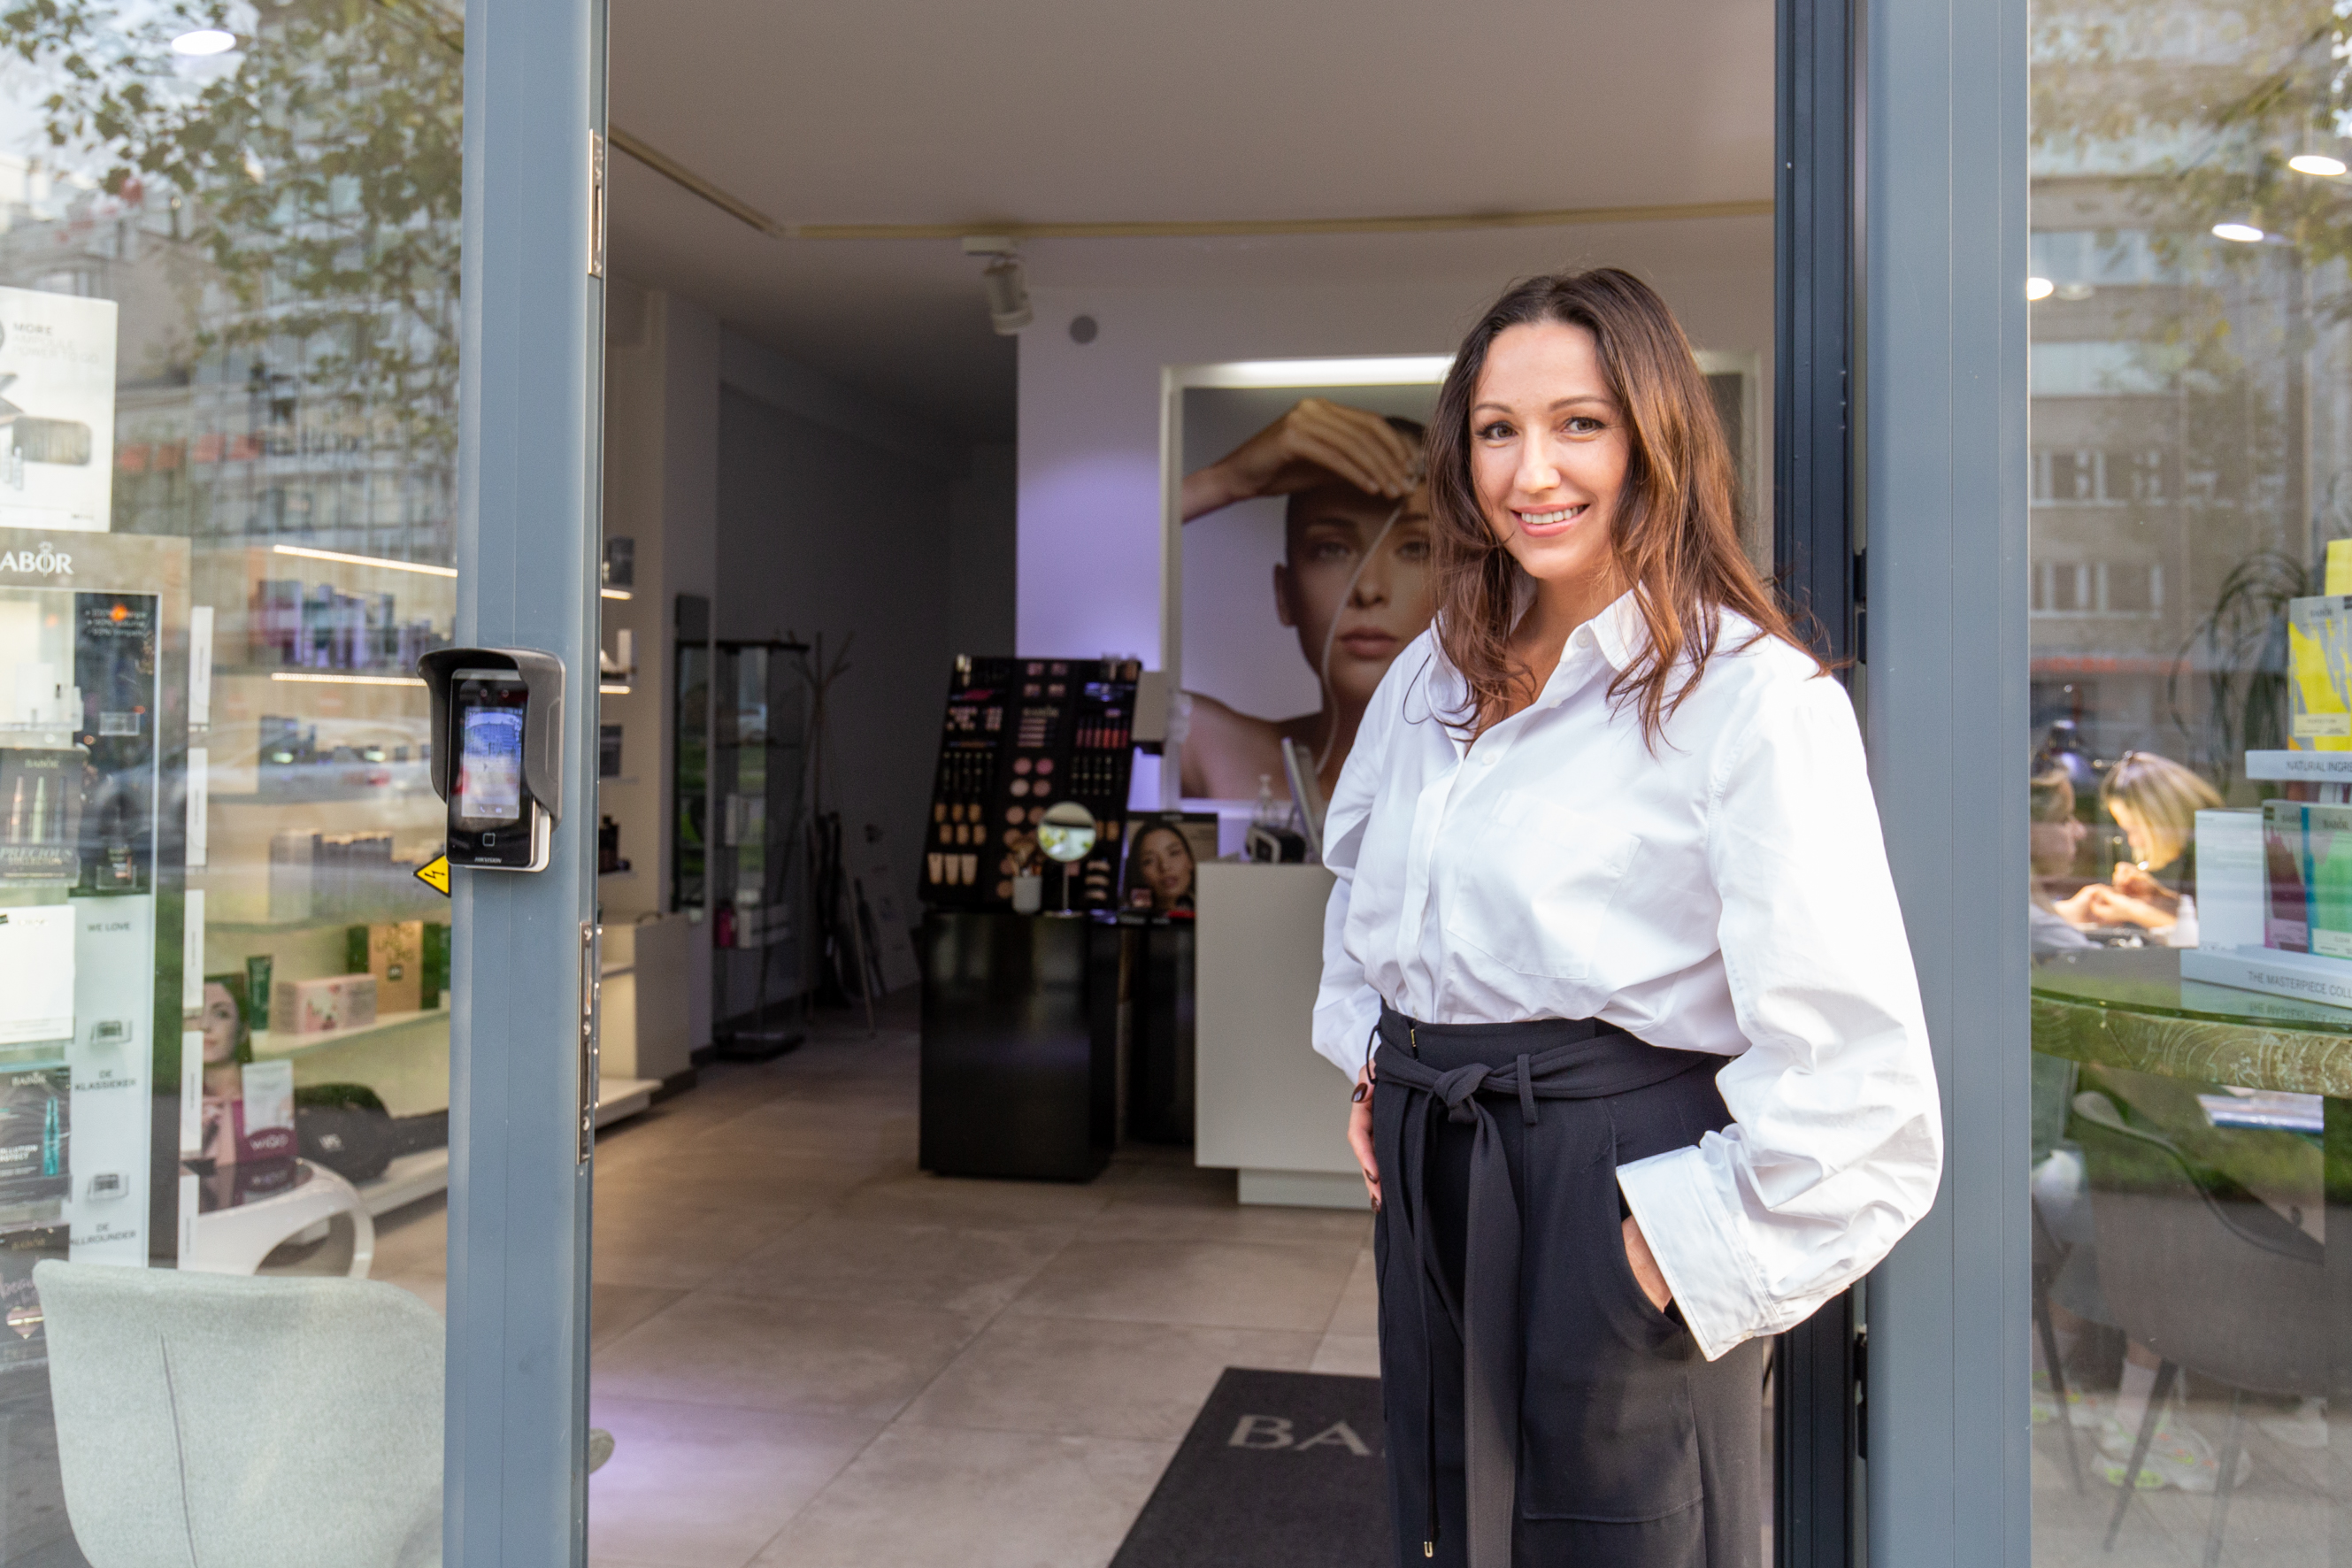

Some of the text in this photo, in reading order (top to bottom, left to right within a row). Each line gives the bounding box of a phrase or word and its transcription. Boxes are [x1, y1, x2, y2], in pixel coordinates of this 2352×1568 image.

[2287, 760, 2325, 772] NATURAL
[87, 921, 131, 932] WE LOVE
[2248, 971, 2264, 984] THE
[2266, 974, 2327, 995] MASTERPIECE
[1227, 1414, 1387, 1458] BA
